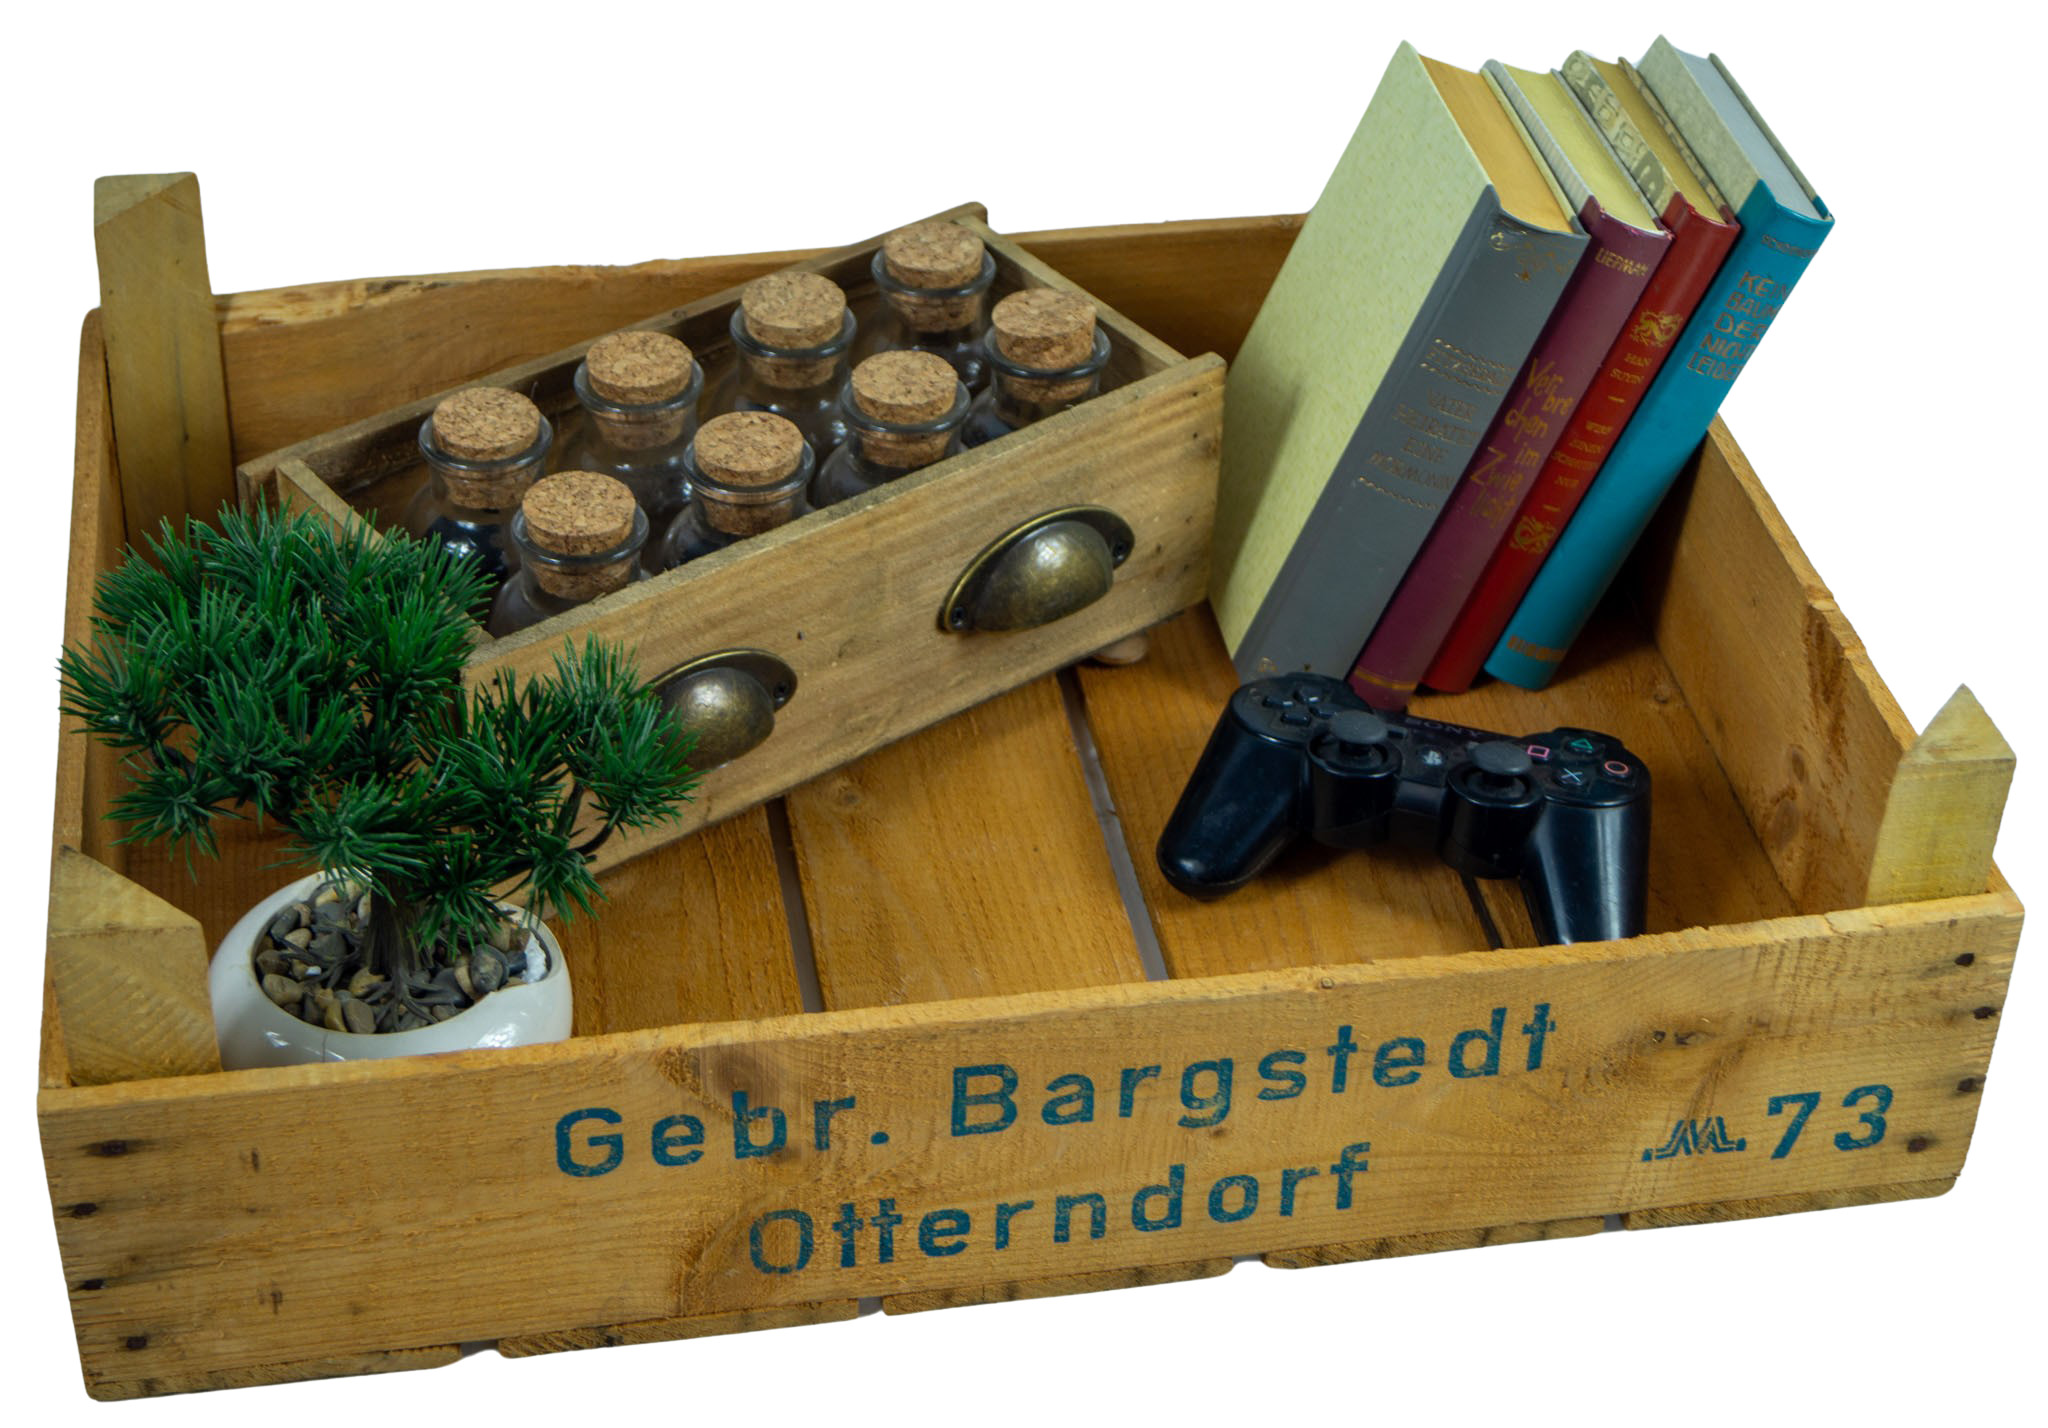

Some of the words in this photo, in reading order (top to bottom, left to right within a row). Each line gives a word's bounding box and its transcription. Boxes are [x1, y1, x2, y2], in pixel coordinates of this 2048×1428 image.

[1738, 271, 1789, 299] KEIN
[1624, 353, 1653, 367] HAN
[1541, 394, 1573, 416] bre
[1515, 441, 1541, 466] im
[556, 1092, 888, 1176] Gebr.
[952, 1004, 1555, 1136] Bargstedt
[750, 1144, 1368, 1272] Otterndorf
